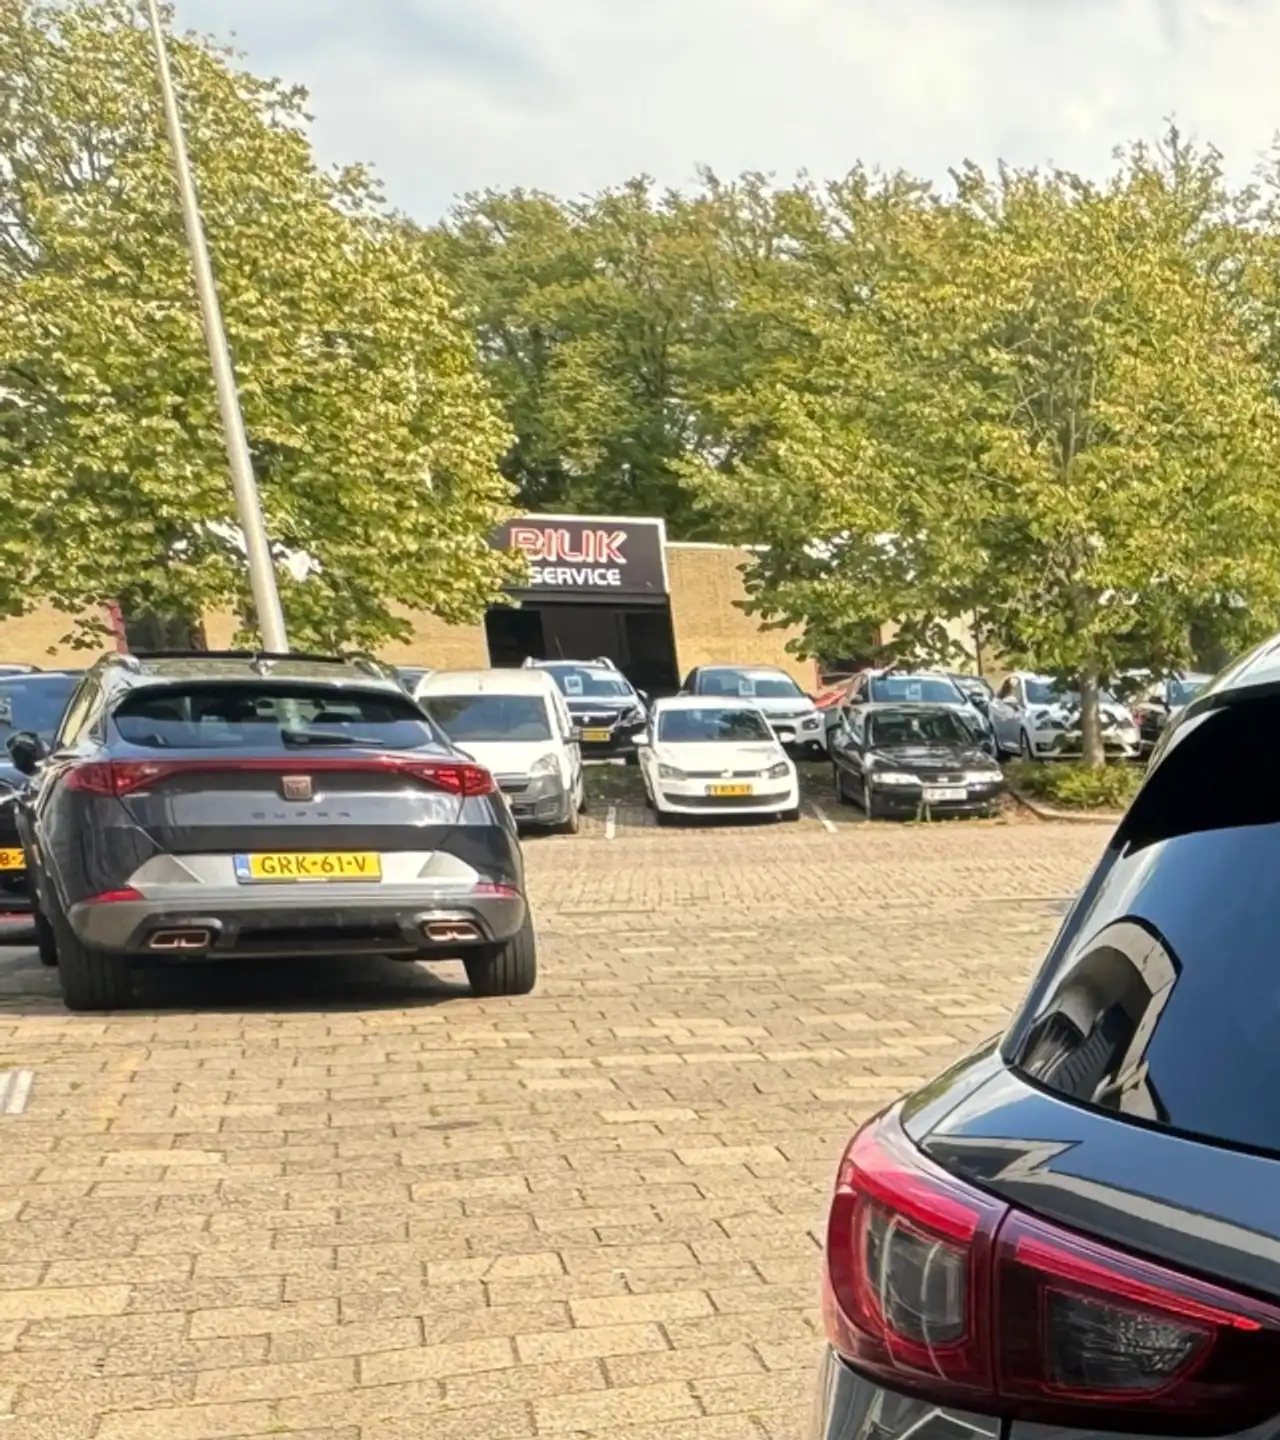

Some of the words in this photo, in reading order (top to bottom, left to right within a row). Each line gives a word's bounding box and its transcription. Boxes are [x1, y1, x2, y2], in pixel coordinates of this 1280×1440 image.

[510, 527, 628, 565] BILIK
[530, 566, 622, 586] SERVICE
[260, 855, 366, 875] GRK-61-V
